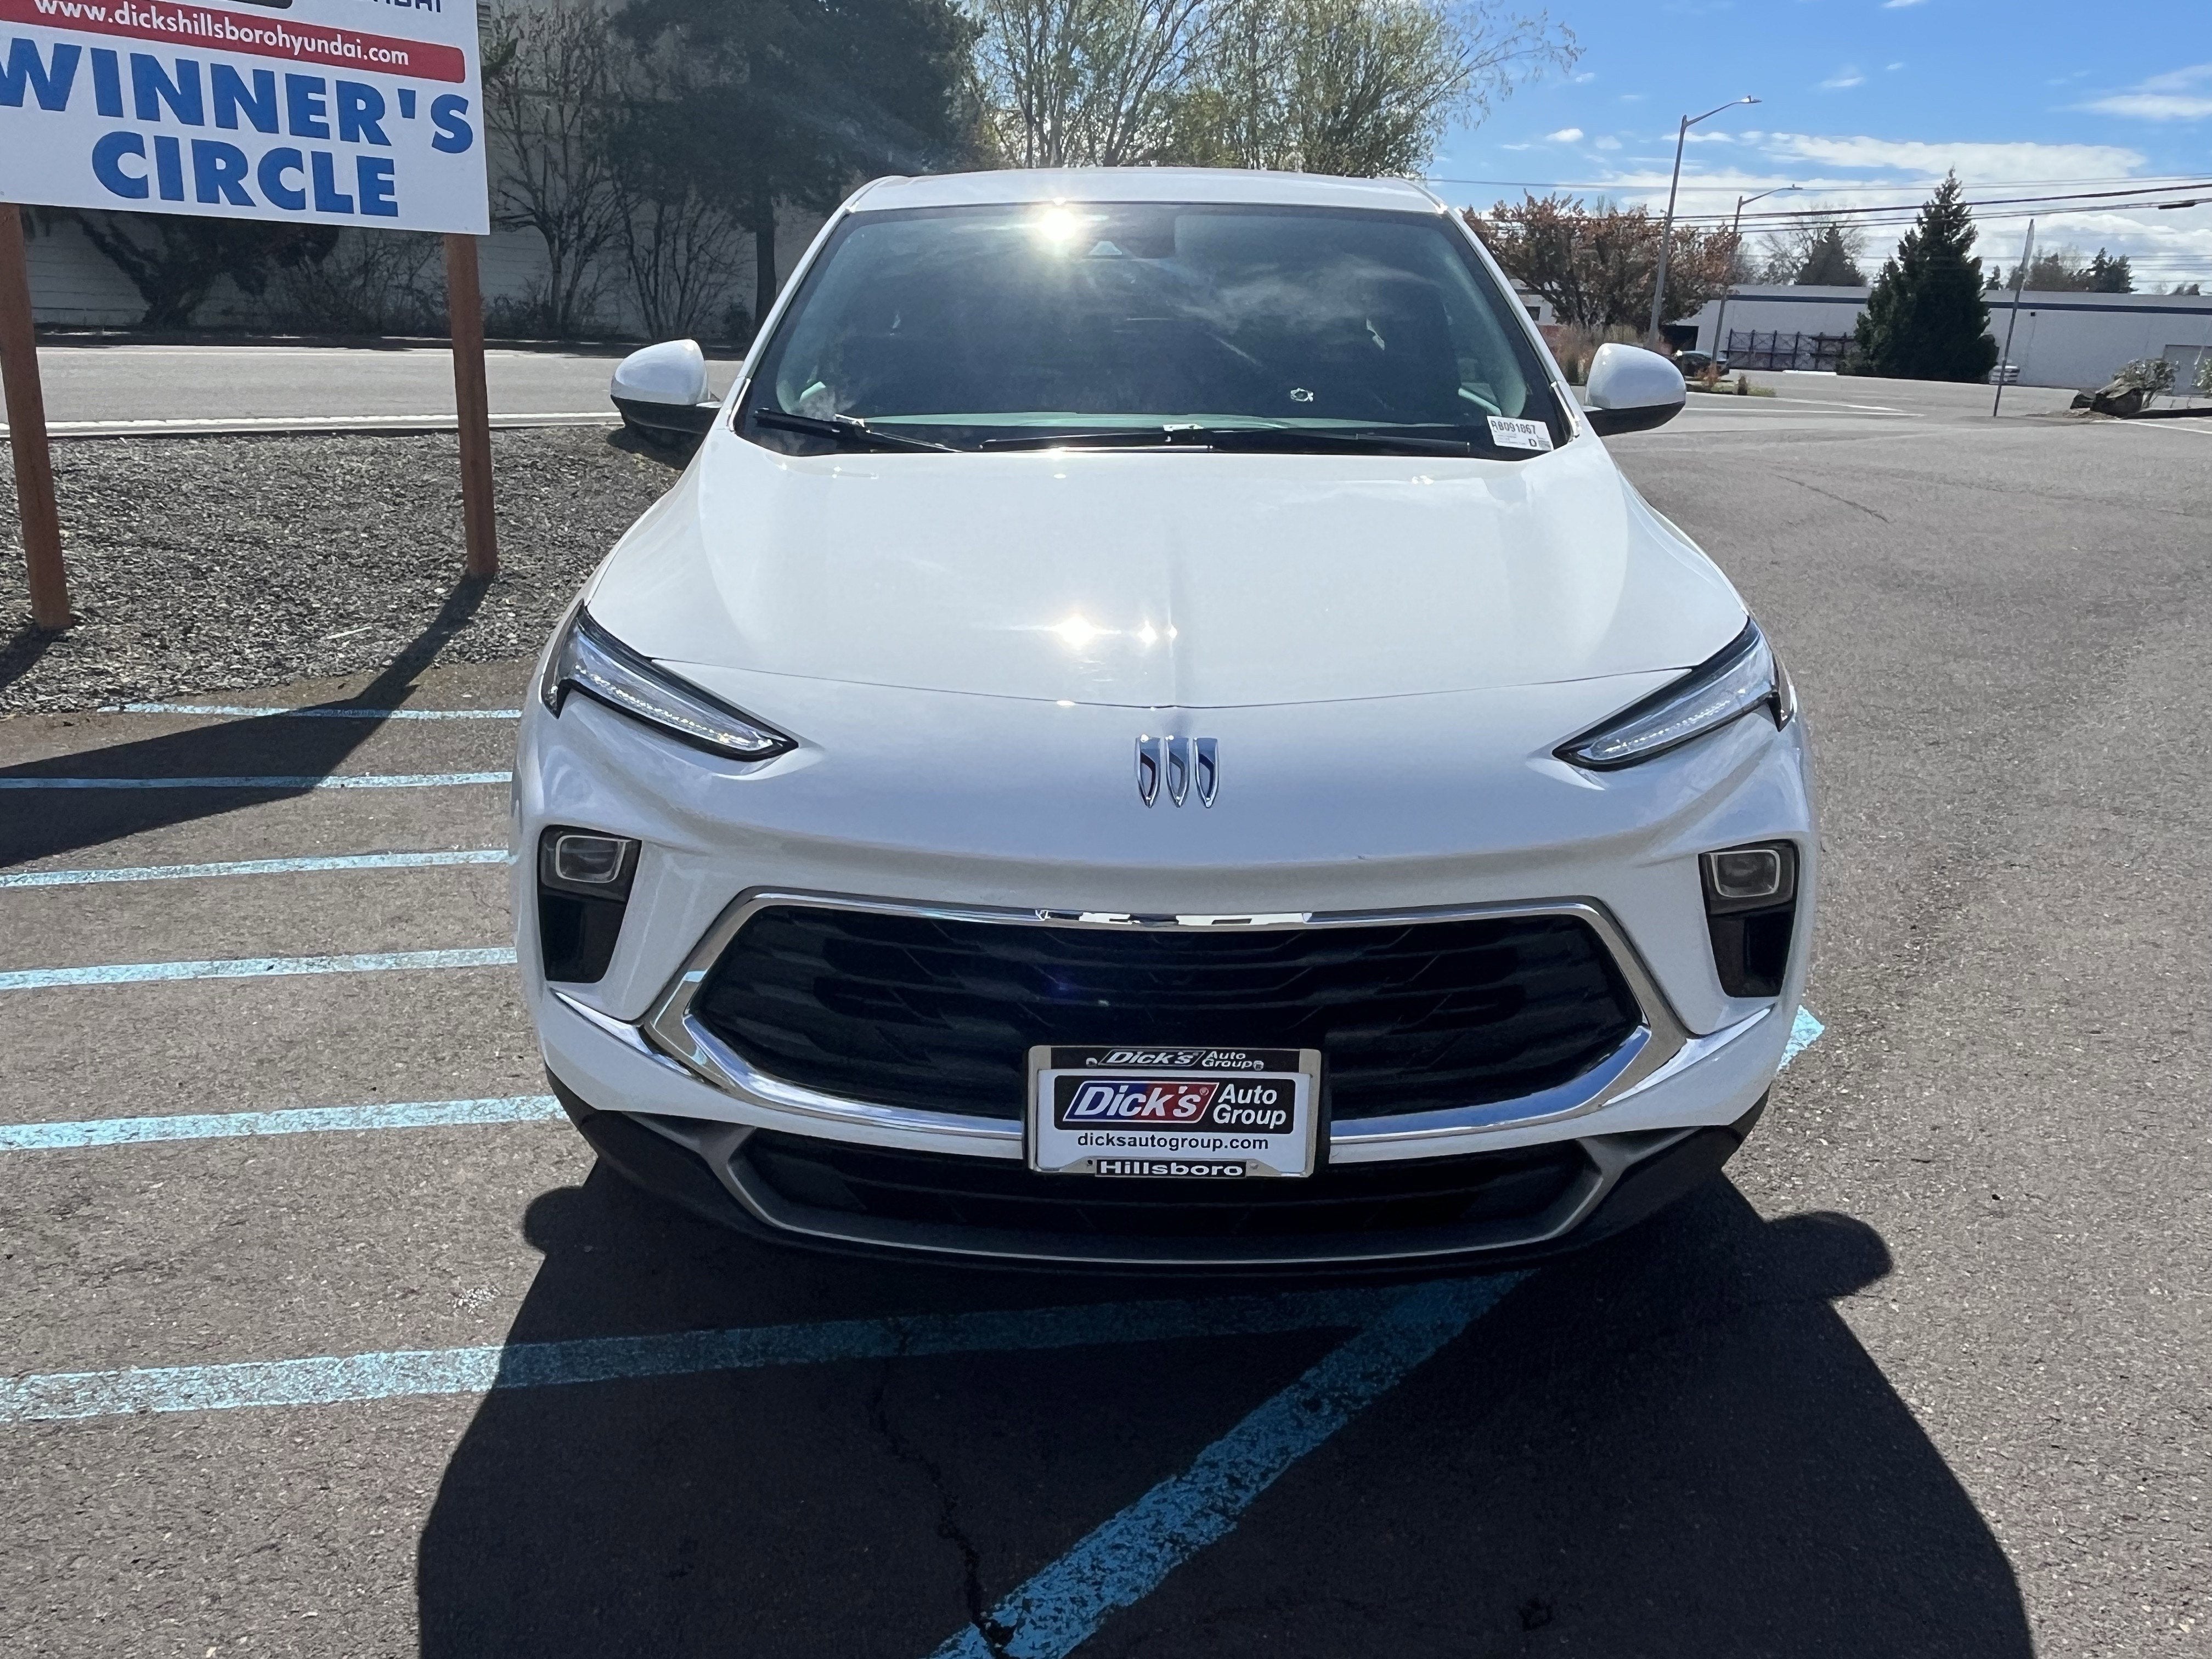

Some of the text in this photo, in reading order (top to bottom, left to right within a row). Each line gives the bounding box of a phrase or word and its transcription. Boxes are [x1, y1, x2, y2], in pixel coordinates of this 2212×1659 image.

[33, 0, 409, 65] www.dickshillsborohyundai.com
[0, 37, 474, 154] WINNER'S
[92, 131, 399, 217] CIRCLE
[1106, 1051, 1195, 1064] Dick's
[1201, 1059, 1252, 1069] Group
[1205, 1051, 1246, 1060] Auto
[1074, 1085, 1201, 1118] Dick's
[1217, 1083, 1277, 1105] Auto
[1213, 1103, 1286, 1129] Group
[1077, 1132, 1269, 1152] dicksautogroup.com
[1100, 1161, 1243, 1176] Hillsboro
